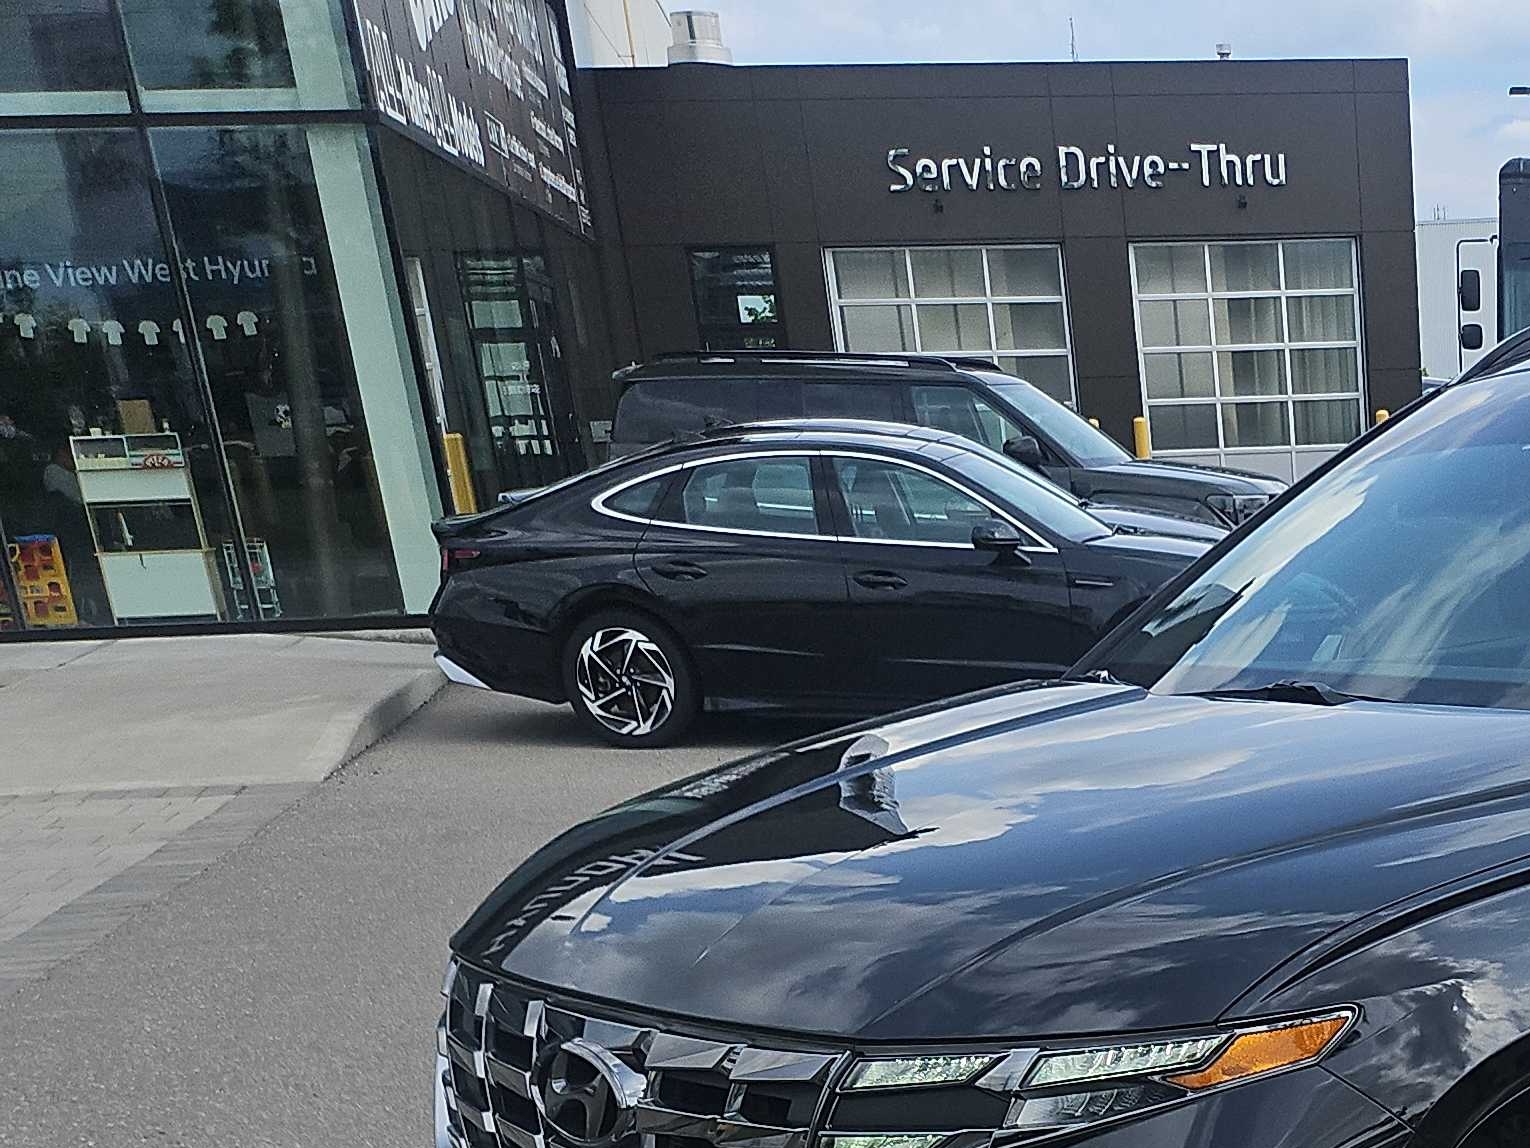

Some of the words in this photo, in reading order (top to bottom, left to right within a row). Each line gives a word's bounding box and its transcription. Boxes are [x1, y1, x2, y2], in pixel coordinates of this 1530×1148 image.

[887, 146, 1042, 192] Service
[1057, 143, 1288, 190] Drive-Thru
[44, 261, 118, 288] View
